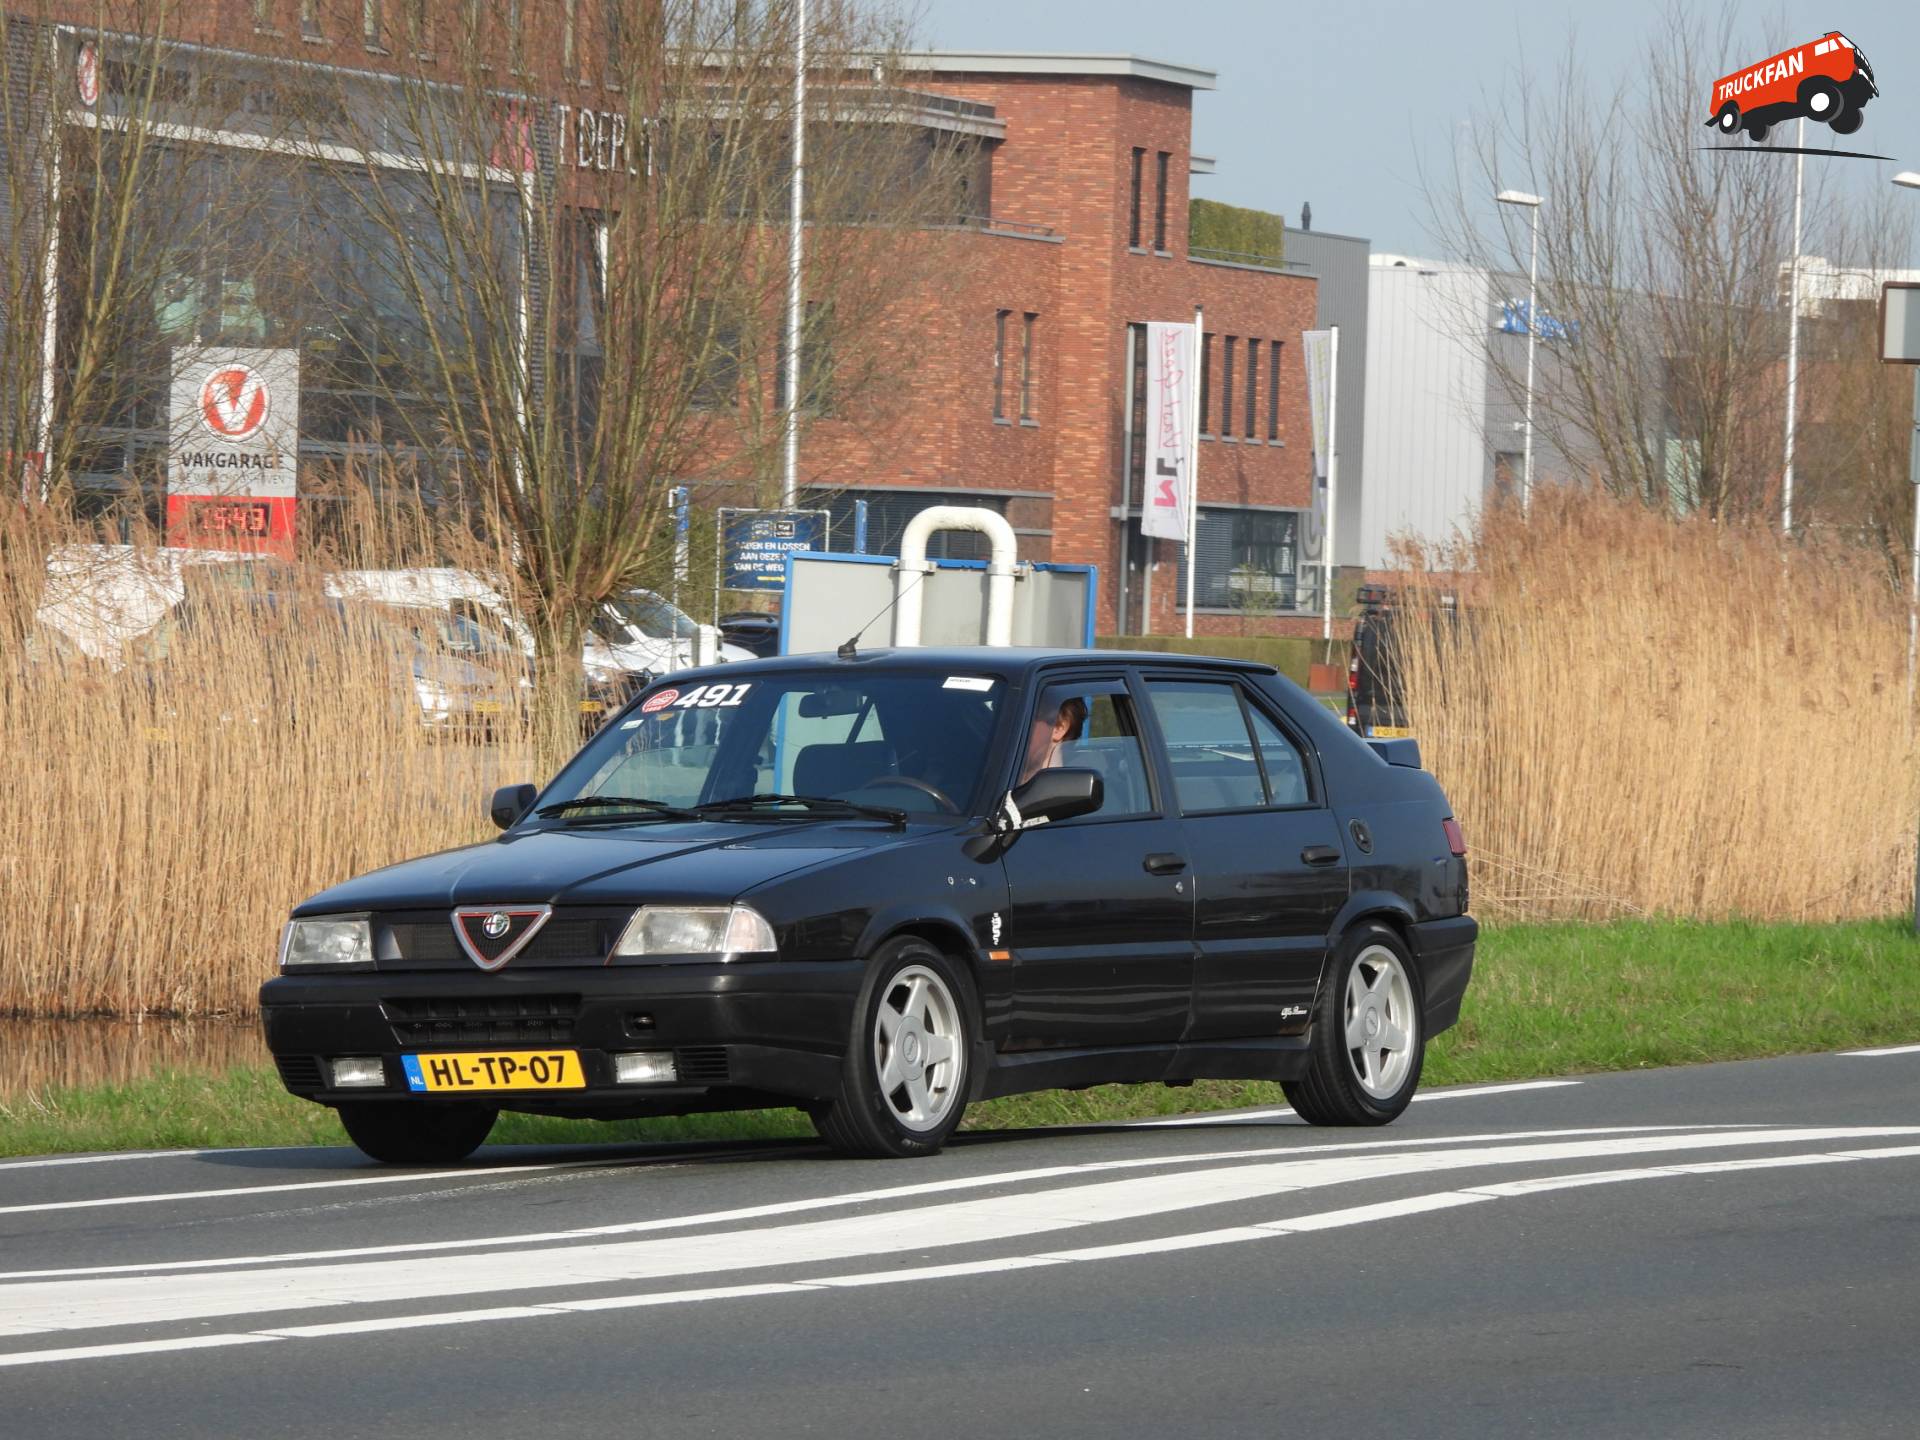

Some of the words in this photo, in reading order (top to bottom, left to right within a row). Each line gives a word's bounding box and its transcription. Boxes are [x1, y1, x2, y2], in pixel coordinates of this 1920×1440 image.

[182, 452, 284, 470] VAKGARAGE
[673, 684, 752, 708] 491
[410, 1076, 423, 1086] NL
[430, 1056, 565, 1086] HL-TP-07
